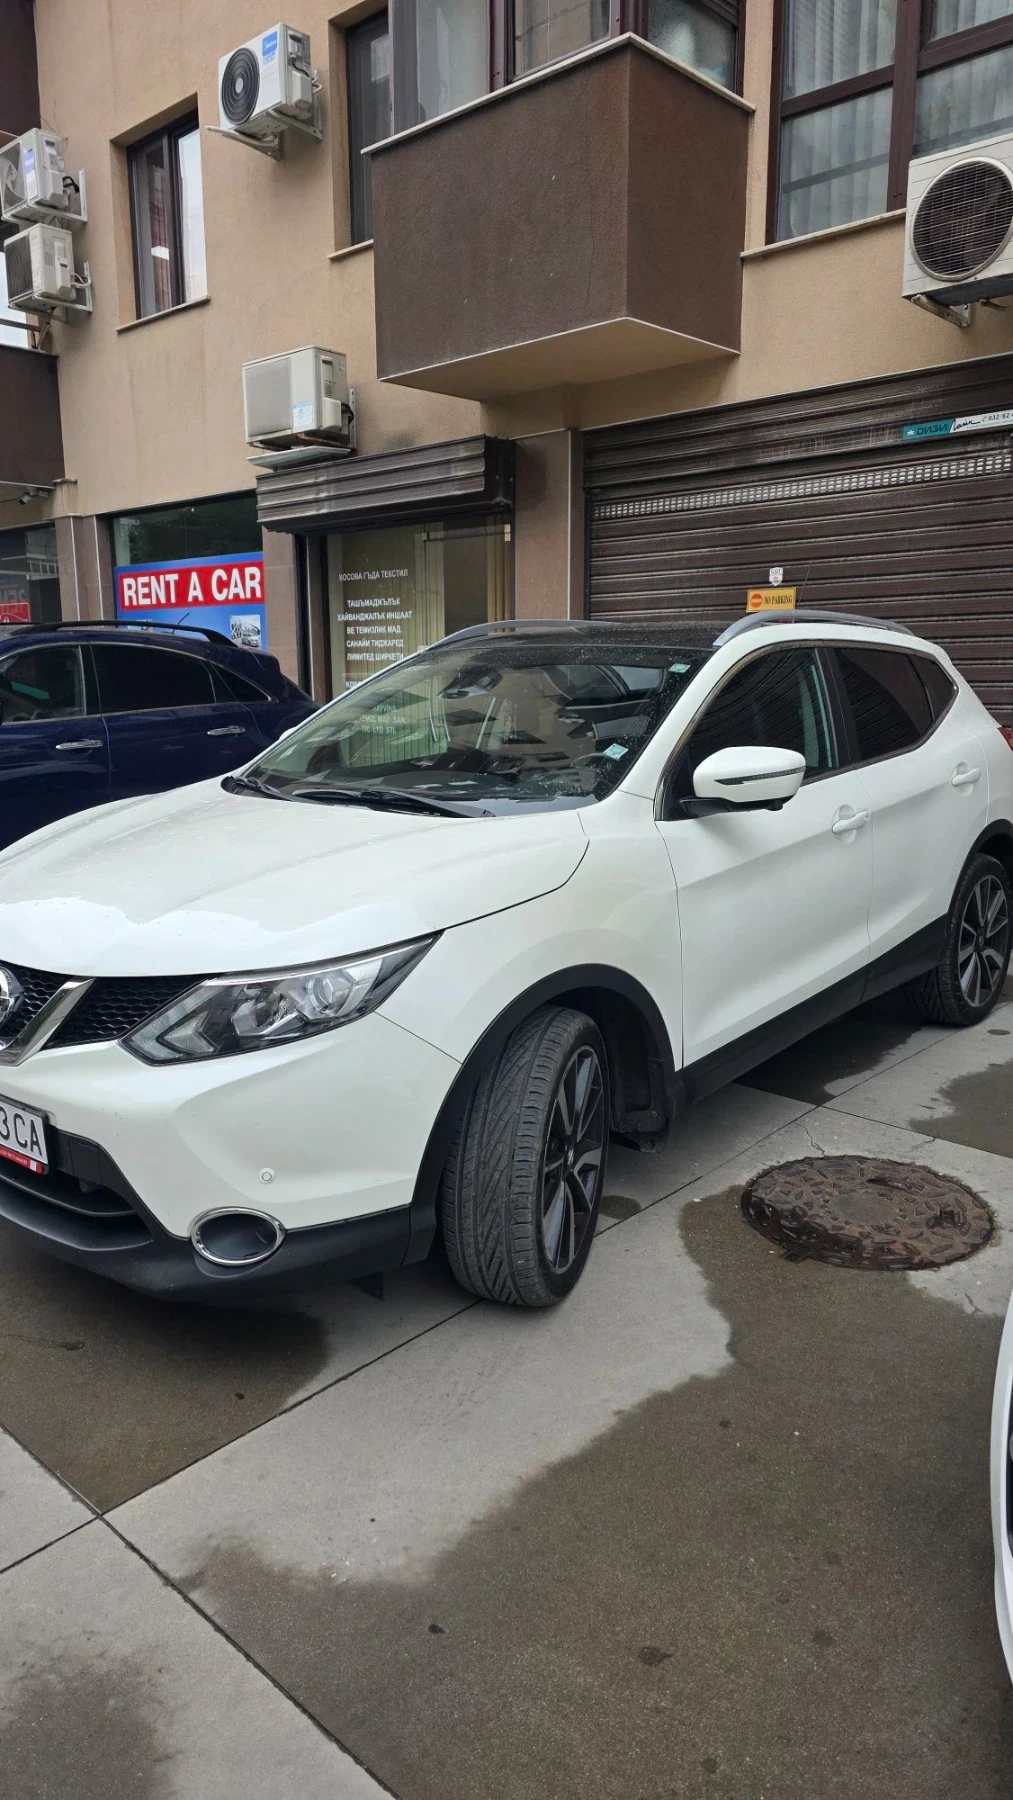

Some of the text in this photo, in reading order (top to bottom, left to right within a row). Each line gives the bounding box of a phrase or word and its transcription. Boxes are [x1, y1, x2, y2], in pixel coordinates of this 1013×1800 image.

[338, 569, 408, 581] КОСОВА ГЪДА ТЕКСТИЛ
[122, 566, 262, 606] RENT A CAR
[771, 594, 793, 604] PARKING
[386, 611, 413, 619] ИНШААТ
[346, 626, 356, 634] ВЕ
[356, 625, 387, 634] ТЕМИЗЛИК
